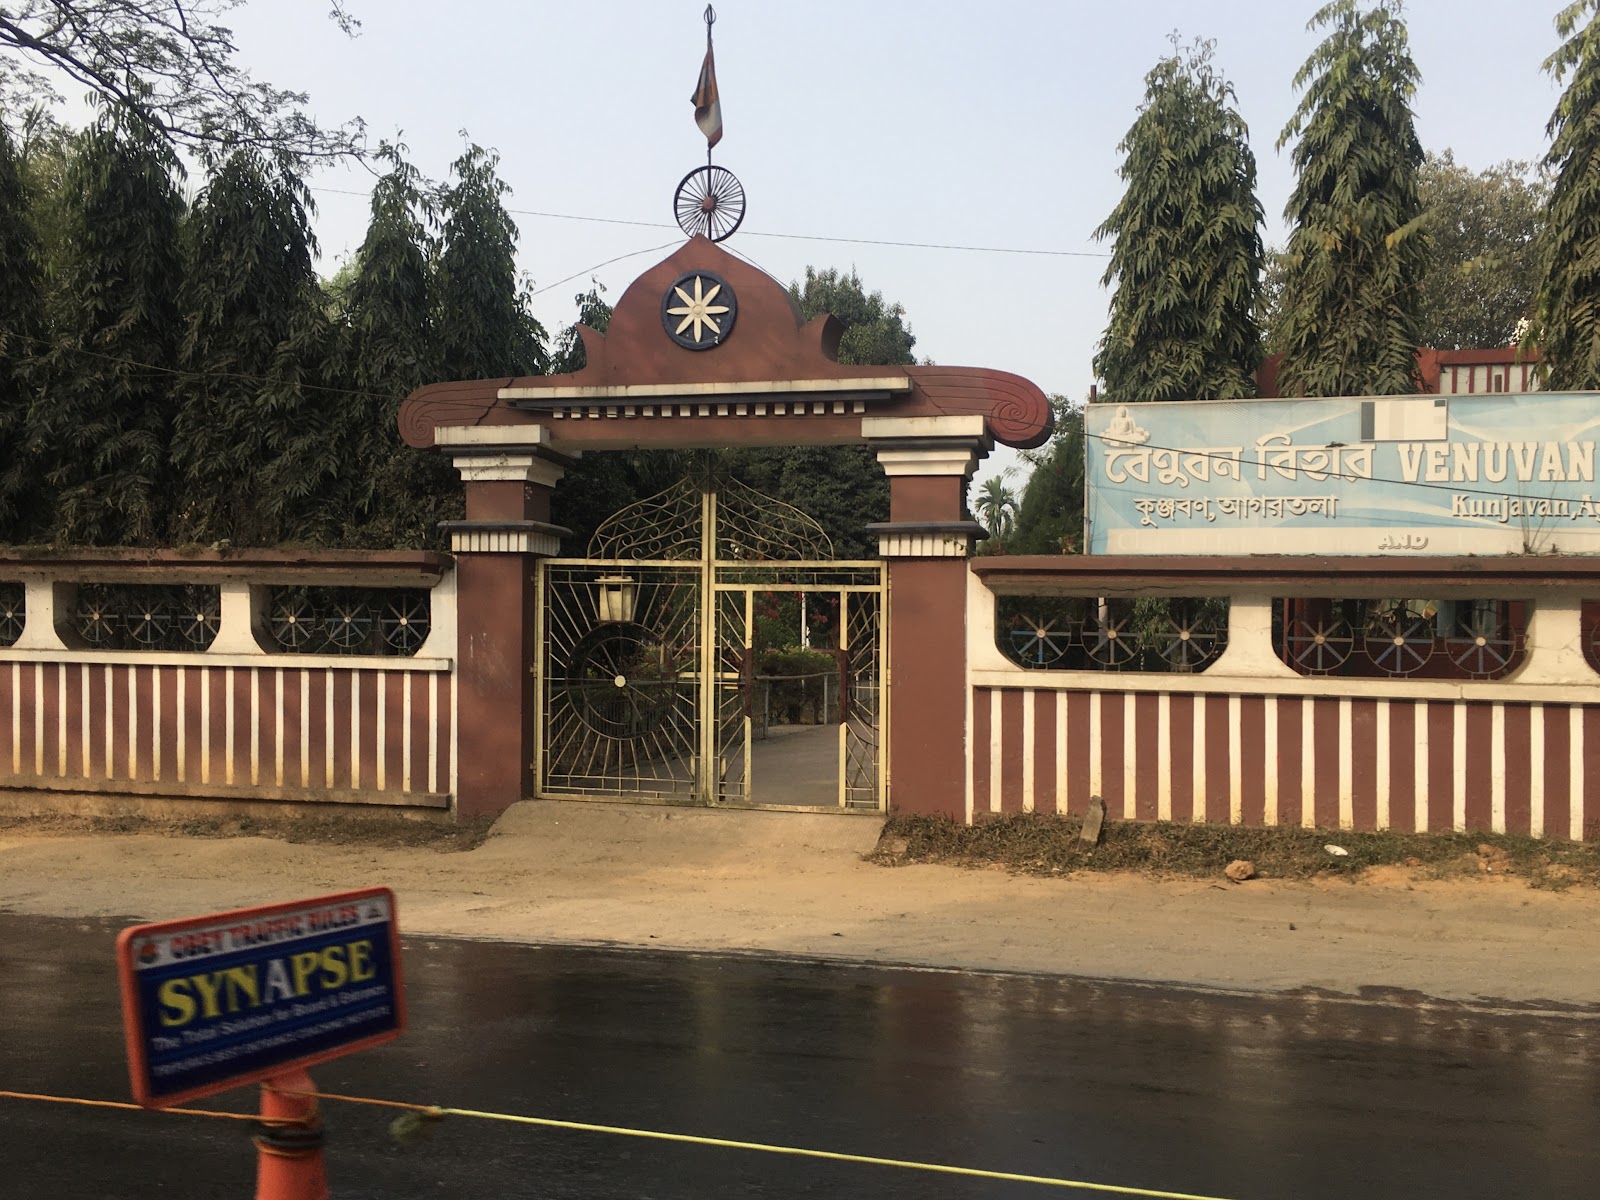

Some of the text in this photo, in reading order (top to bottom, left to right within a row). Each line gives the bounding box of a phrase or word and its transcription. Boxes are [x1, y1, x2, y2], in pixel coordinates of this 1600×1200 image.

[1254, 432, 1376, 483] বিহার
[1397, 440, 1596, 483] VENUVAN
[158, 939, 377, 1027] SYNAPSE
